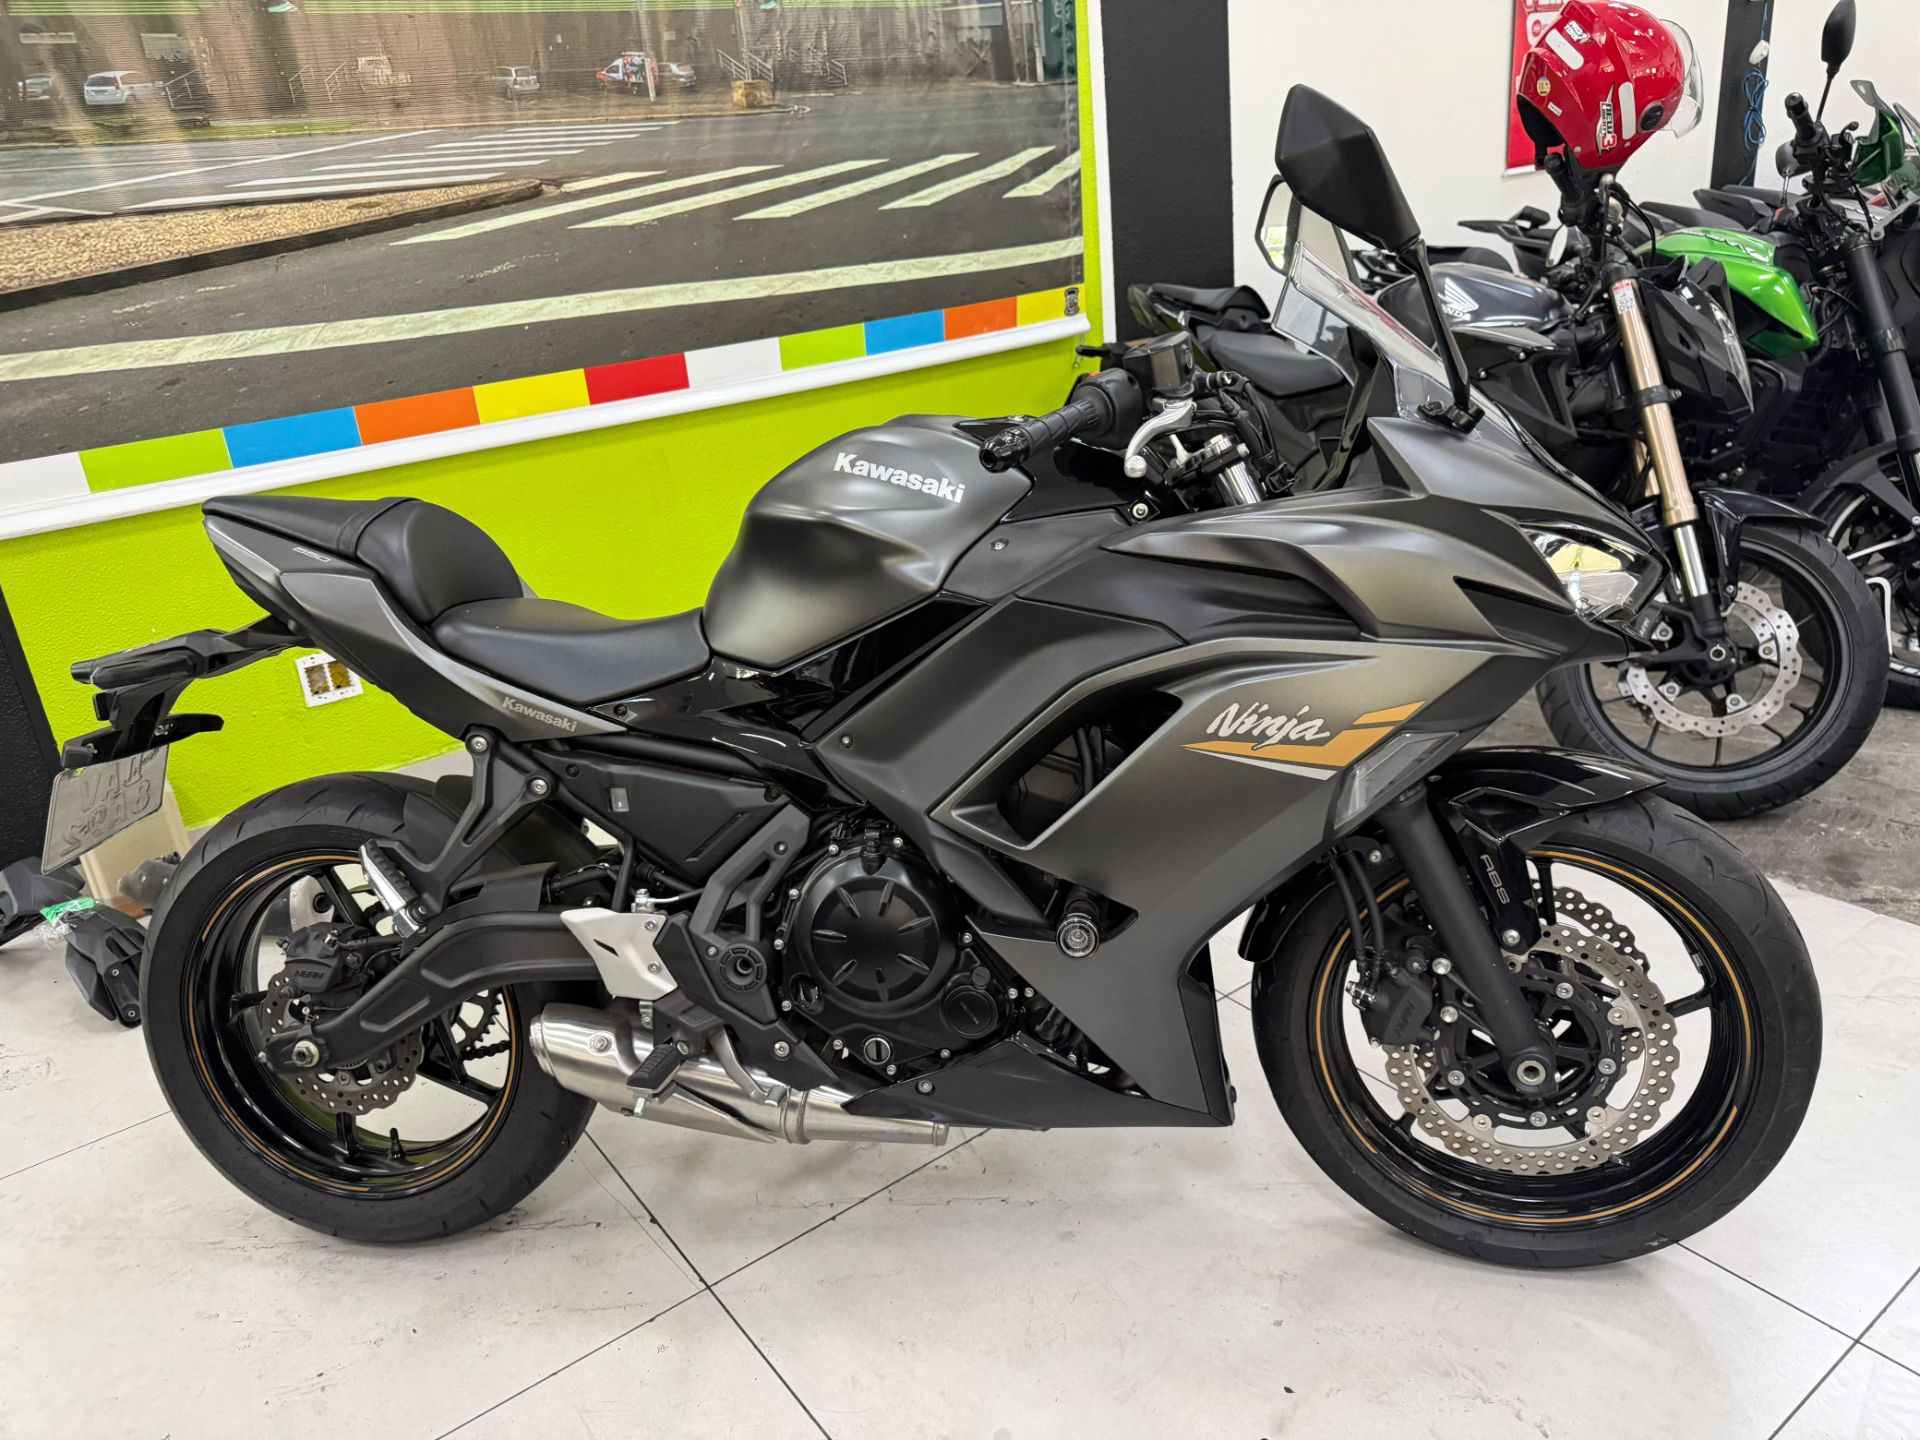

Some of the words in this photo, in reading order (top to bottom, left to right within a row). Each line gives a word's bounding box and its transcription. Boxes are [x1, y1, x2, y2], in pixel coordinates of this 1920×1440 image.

[833, 452, 966, 504] Kawasaki
[502, 696, 578, 732] Kawasaki
[1206, 701, 1330, 750] Ninja
[1480, 854, 1510, 904] ABS
